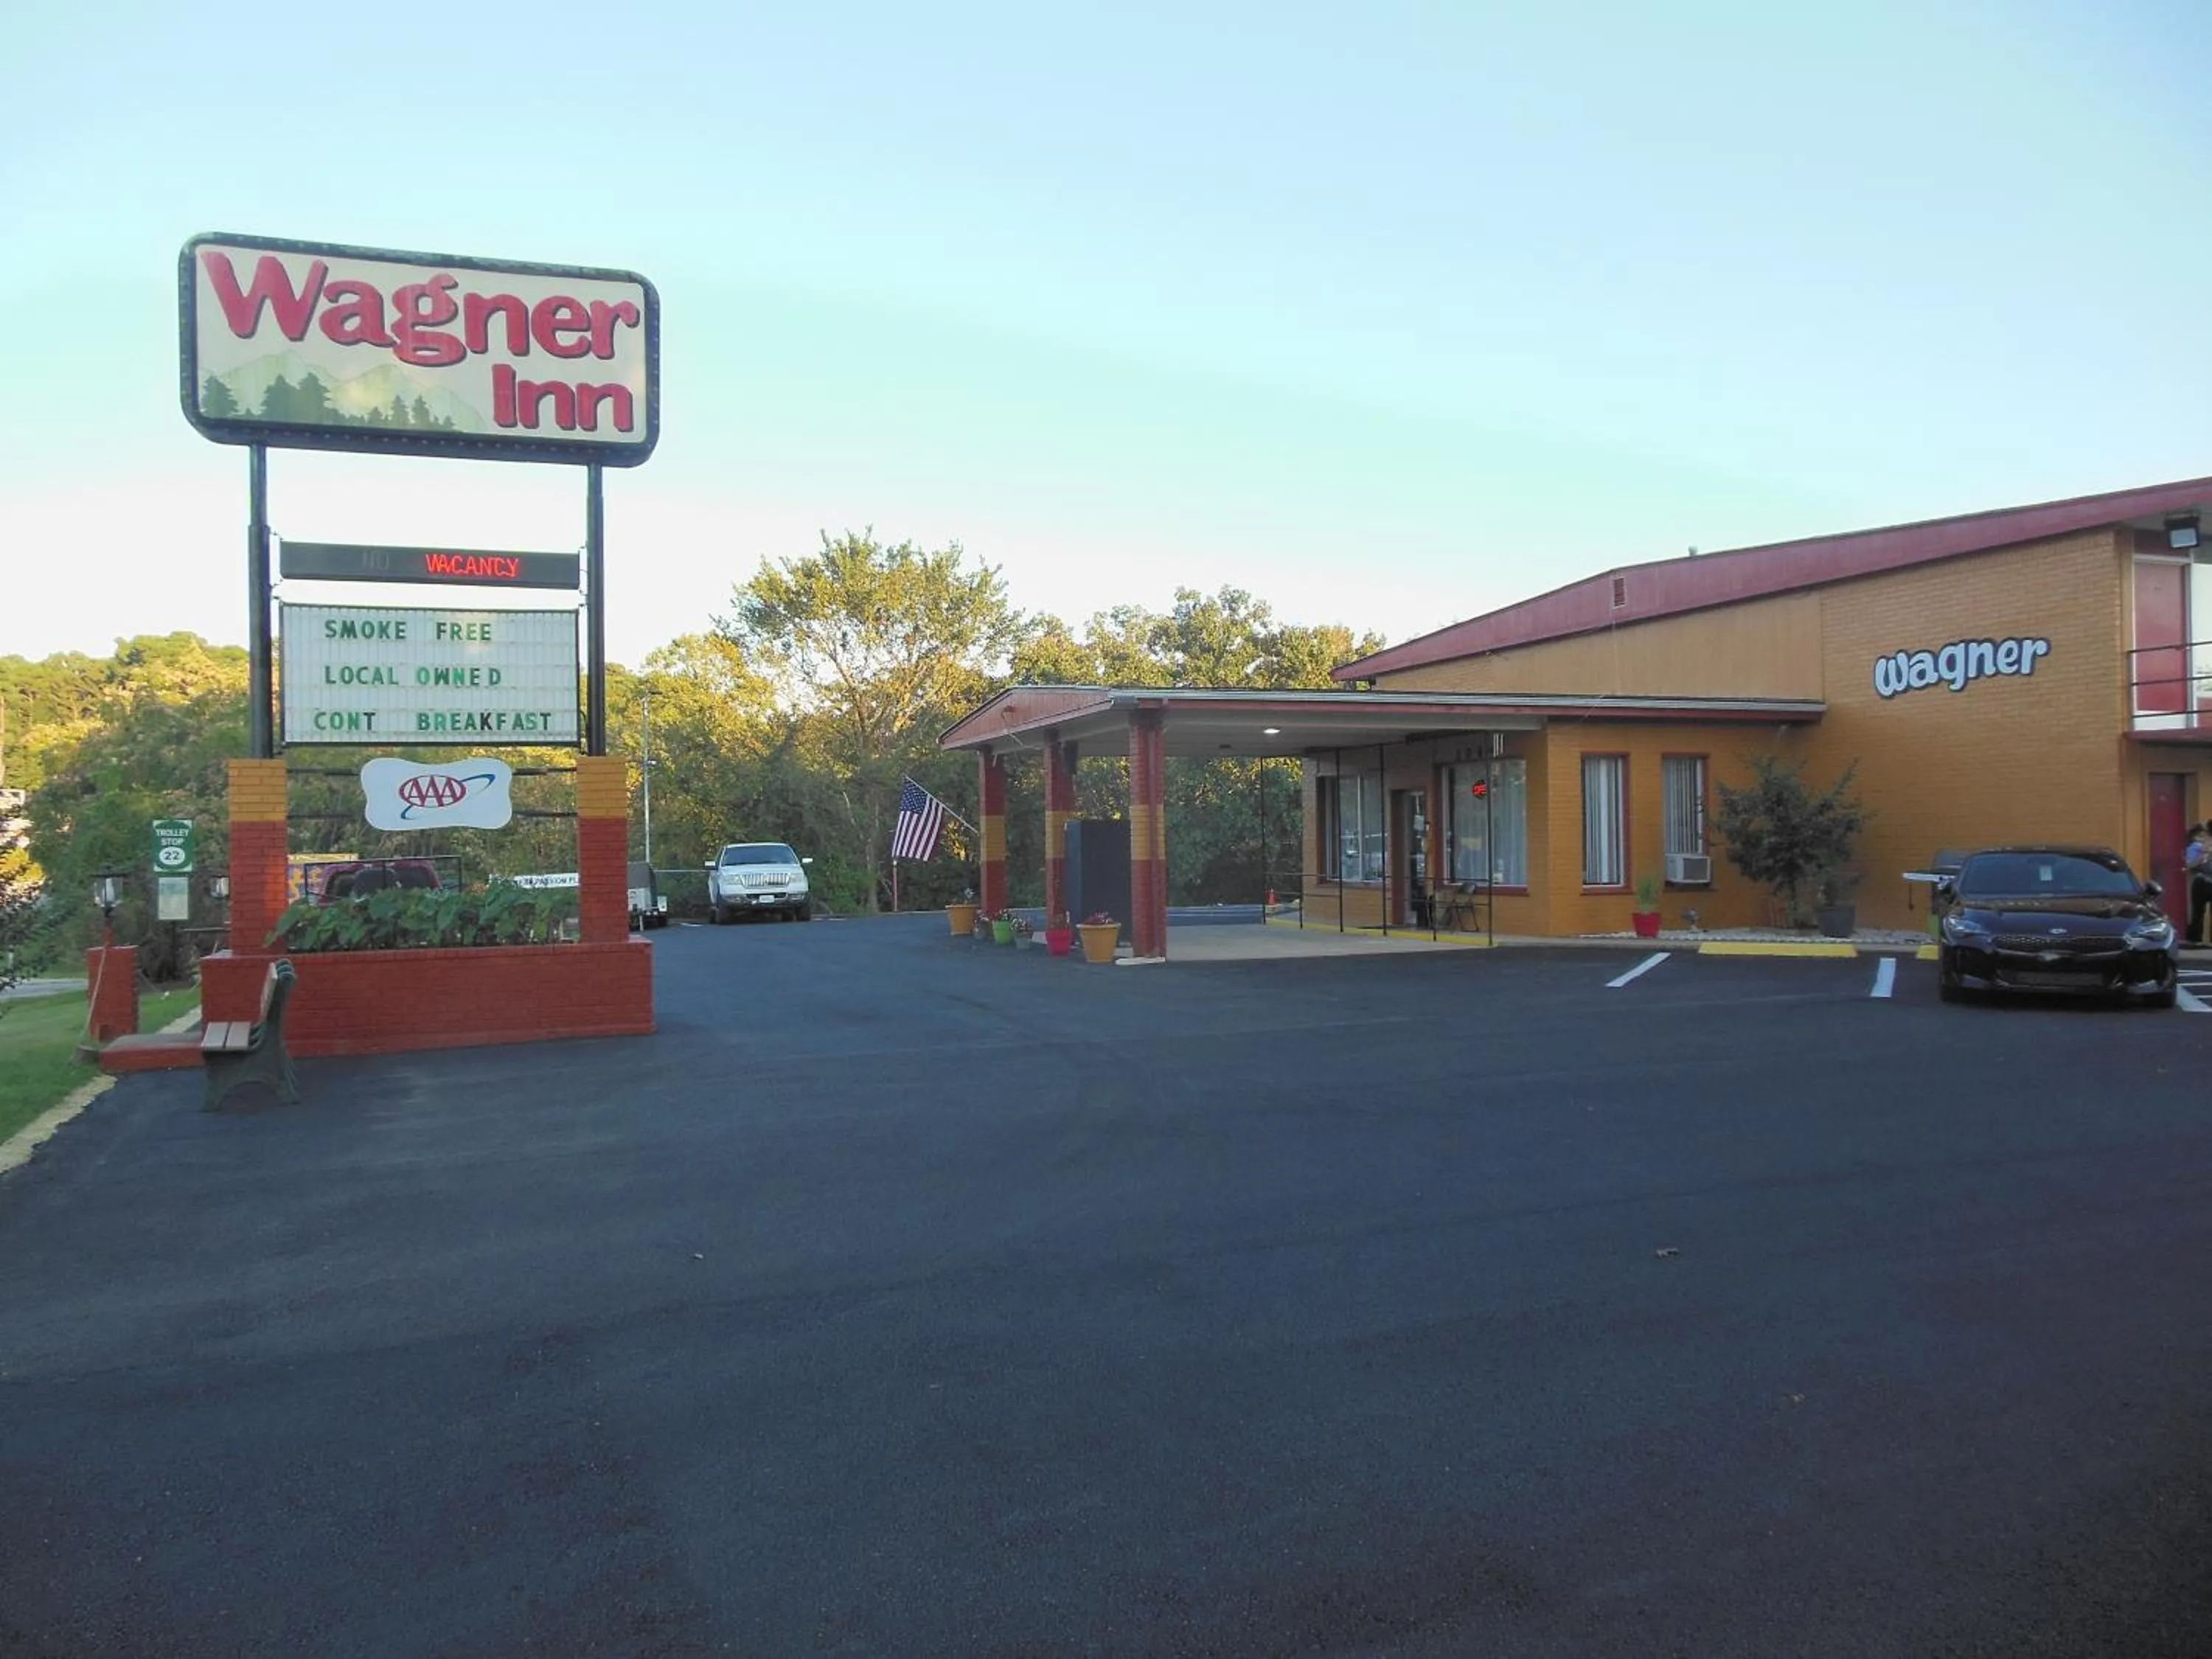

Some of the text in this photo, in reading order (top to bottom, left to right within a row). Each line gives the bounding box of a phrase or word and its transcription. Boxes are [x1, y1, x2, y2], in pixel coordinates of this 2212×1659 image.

[200, 251, 640, 367] Wagner
[491, 364, 634, 431] Inn
[425, 553, 519, 578] VACANCY
[324, 619, 492, 641] SMOKE FREE
[325, 666, 501, 686] LOCAL OWNED
[313, 712, 552, 731] CONT BREAKFAST
[405, 775, 459, 807] AAA
[156, 828, 189, 837] TROLLEY
[161, 837, 184, 846] STOP
[164, 851, 179, 860] 22
